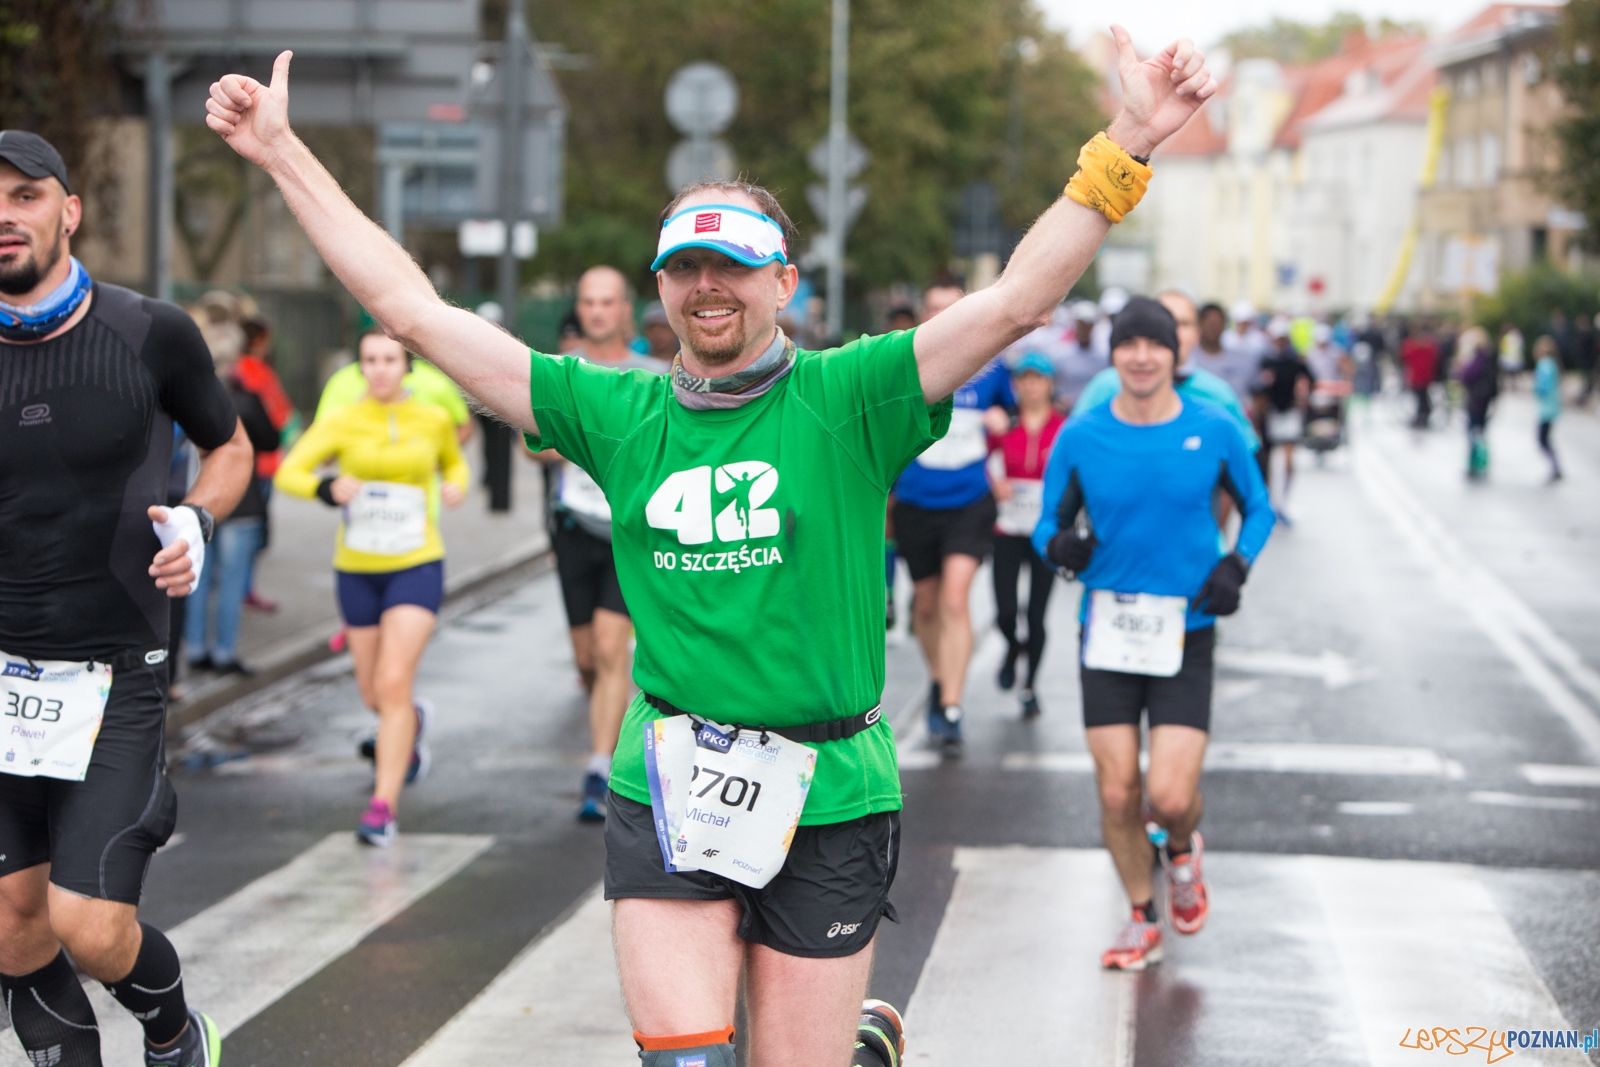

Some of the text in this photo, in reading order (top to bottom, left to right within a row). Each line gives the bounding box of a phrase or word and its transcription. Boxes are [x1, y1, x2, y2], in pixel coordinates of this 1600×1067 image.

[645, 460, 780, 545] 42
[654, 544, 783, 574] DO SZCZĘŚCIA
[5, 691, 63, 722] 303
[702, 731, 729, 747] PKO
[736, 745, 777, 763] maraton
[702, 848, 720, 858] 4F
